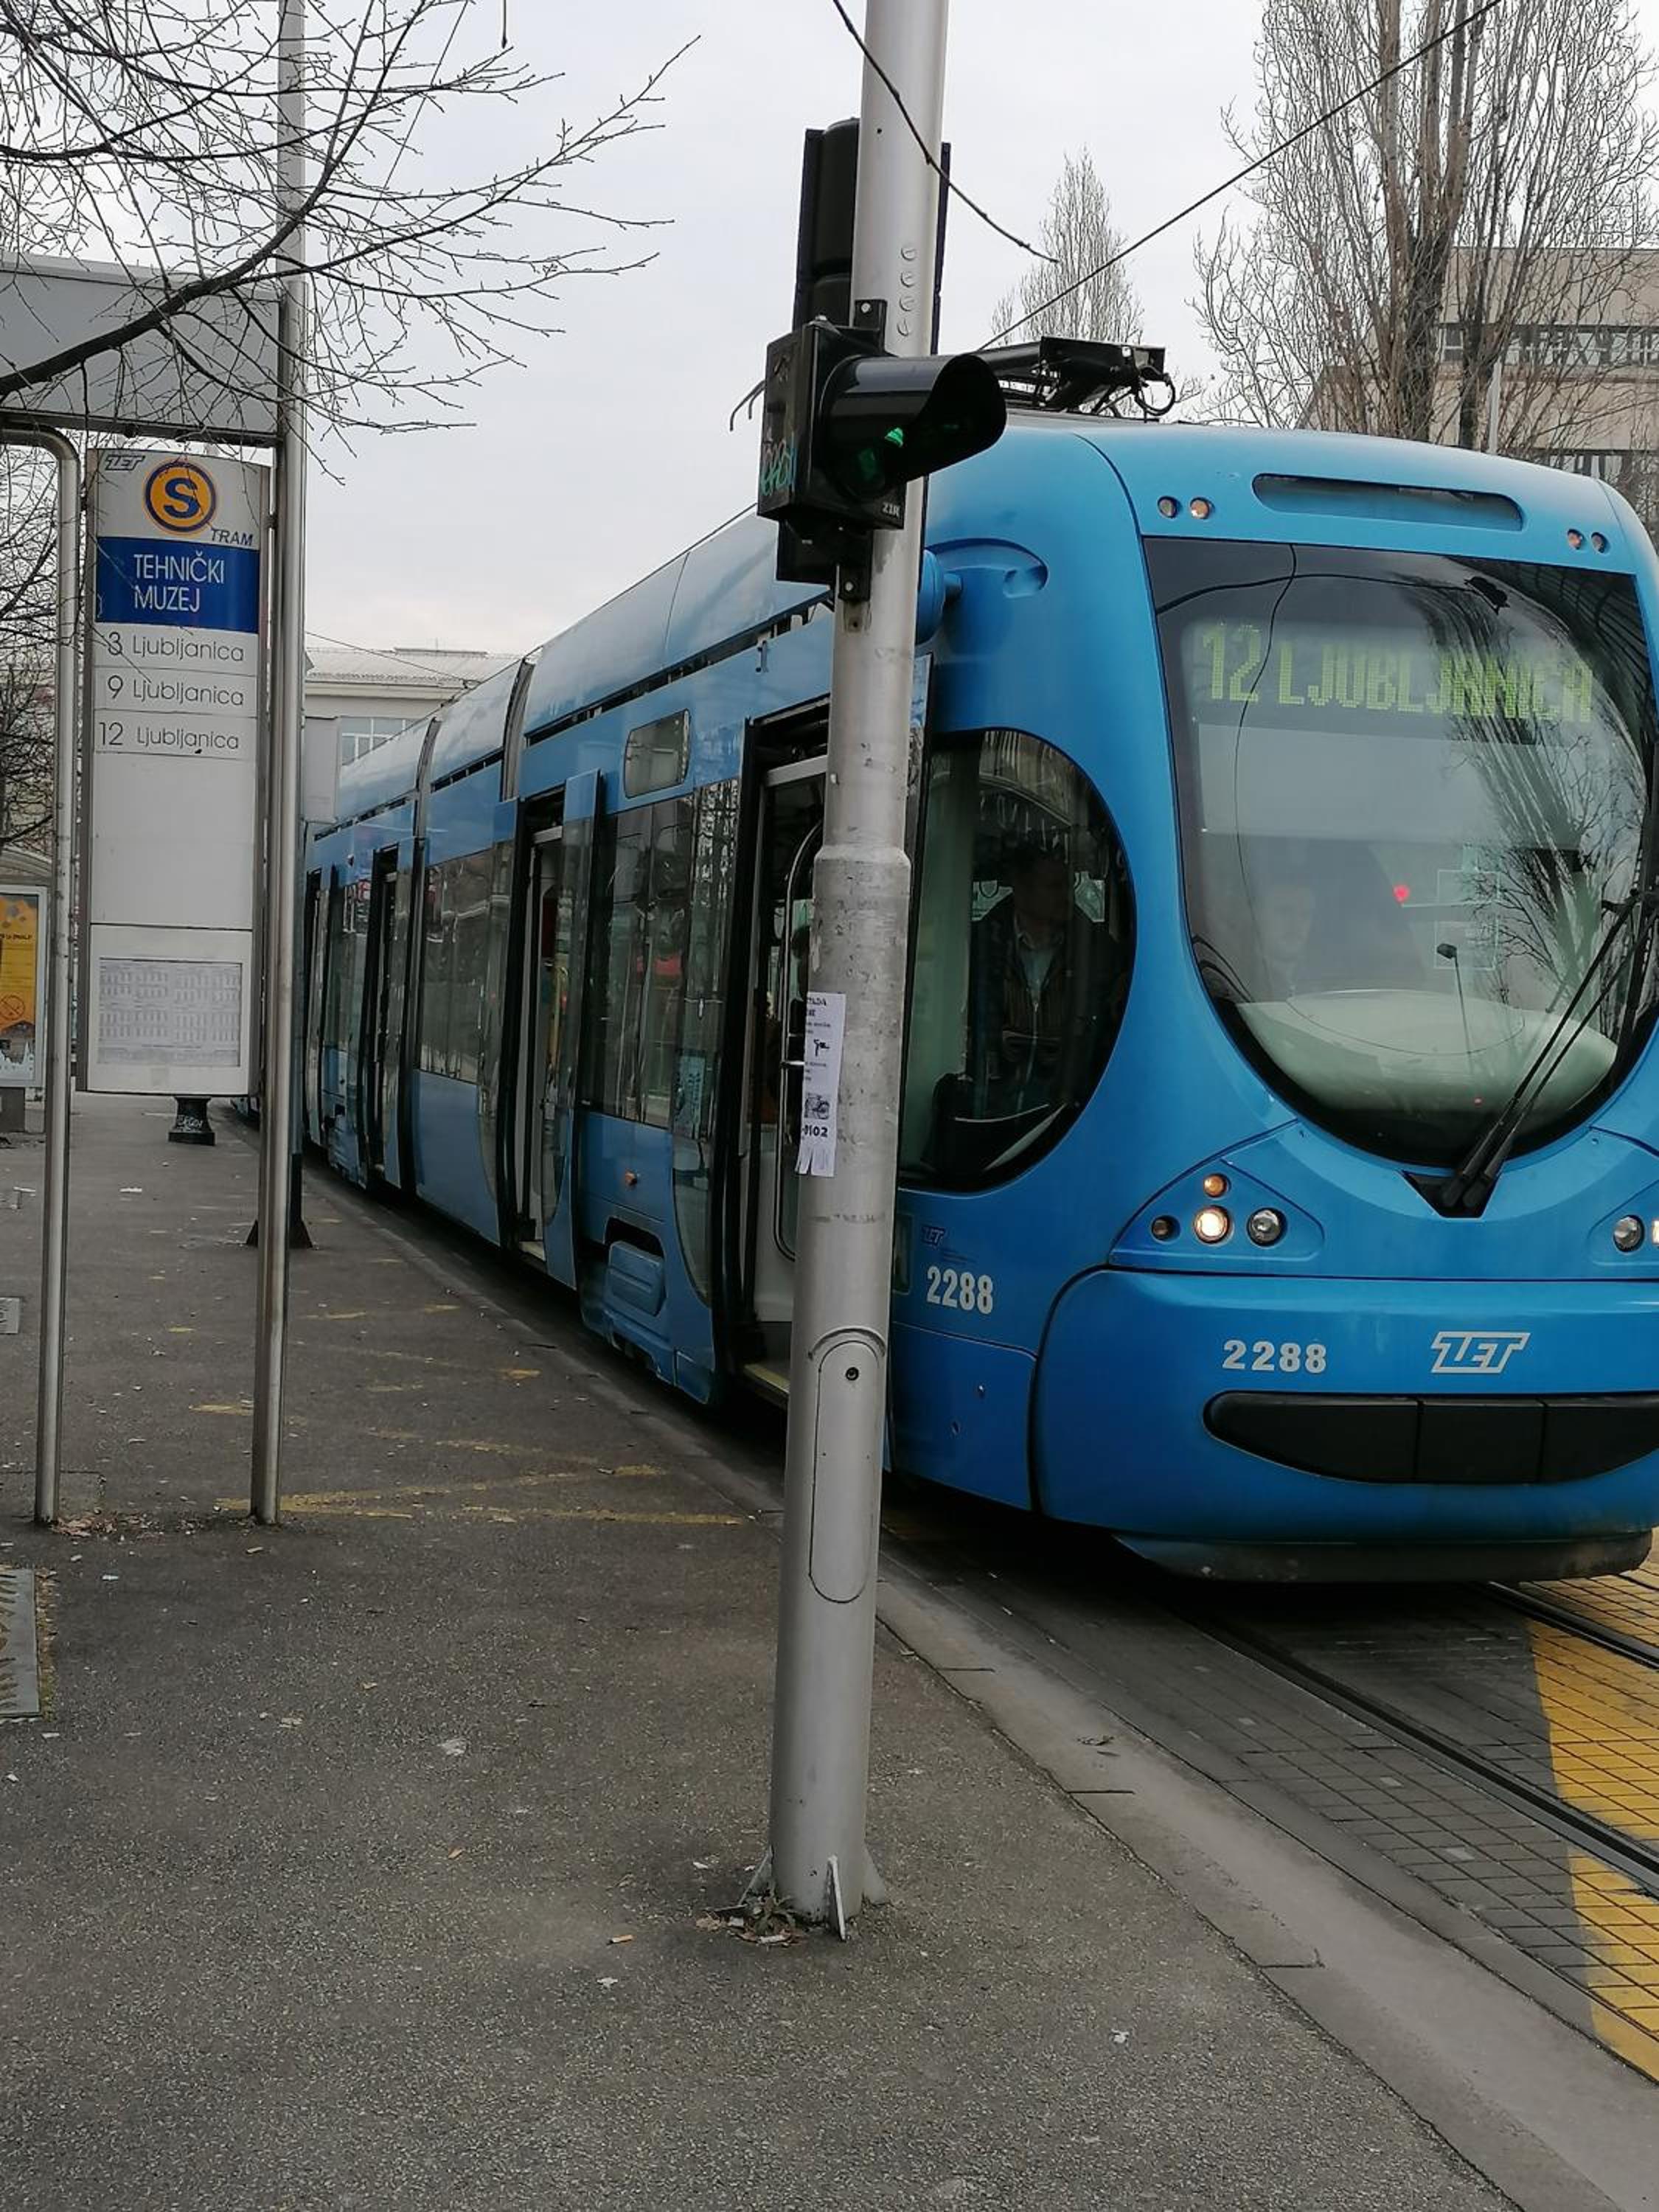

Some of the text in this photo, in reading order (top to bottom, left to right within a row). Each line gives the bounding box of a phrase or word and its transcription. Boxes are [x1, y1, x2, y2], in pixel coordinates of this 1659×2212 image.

[163, 477, 201, 518] S
[211, 528, 254, 546] TRAM
[133, 551, 225, 584] TEHNIČKI
[134, 586, 201, 613] MUZEJ
[108, 631, 244, 662] 3 Ljubljanica
[1203, 624, 1262, 703] 12
[107, 675, 244, 706] 9 Ljubljanica
[99, 721, 239, 750] 12 Ljubljanica
[926, 1265, 993, 1315] 2288
[1222, 1331, 1531, 1374] 2288 ZET
